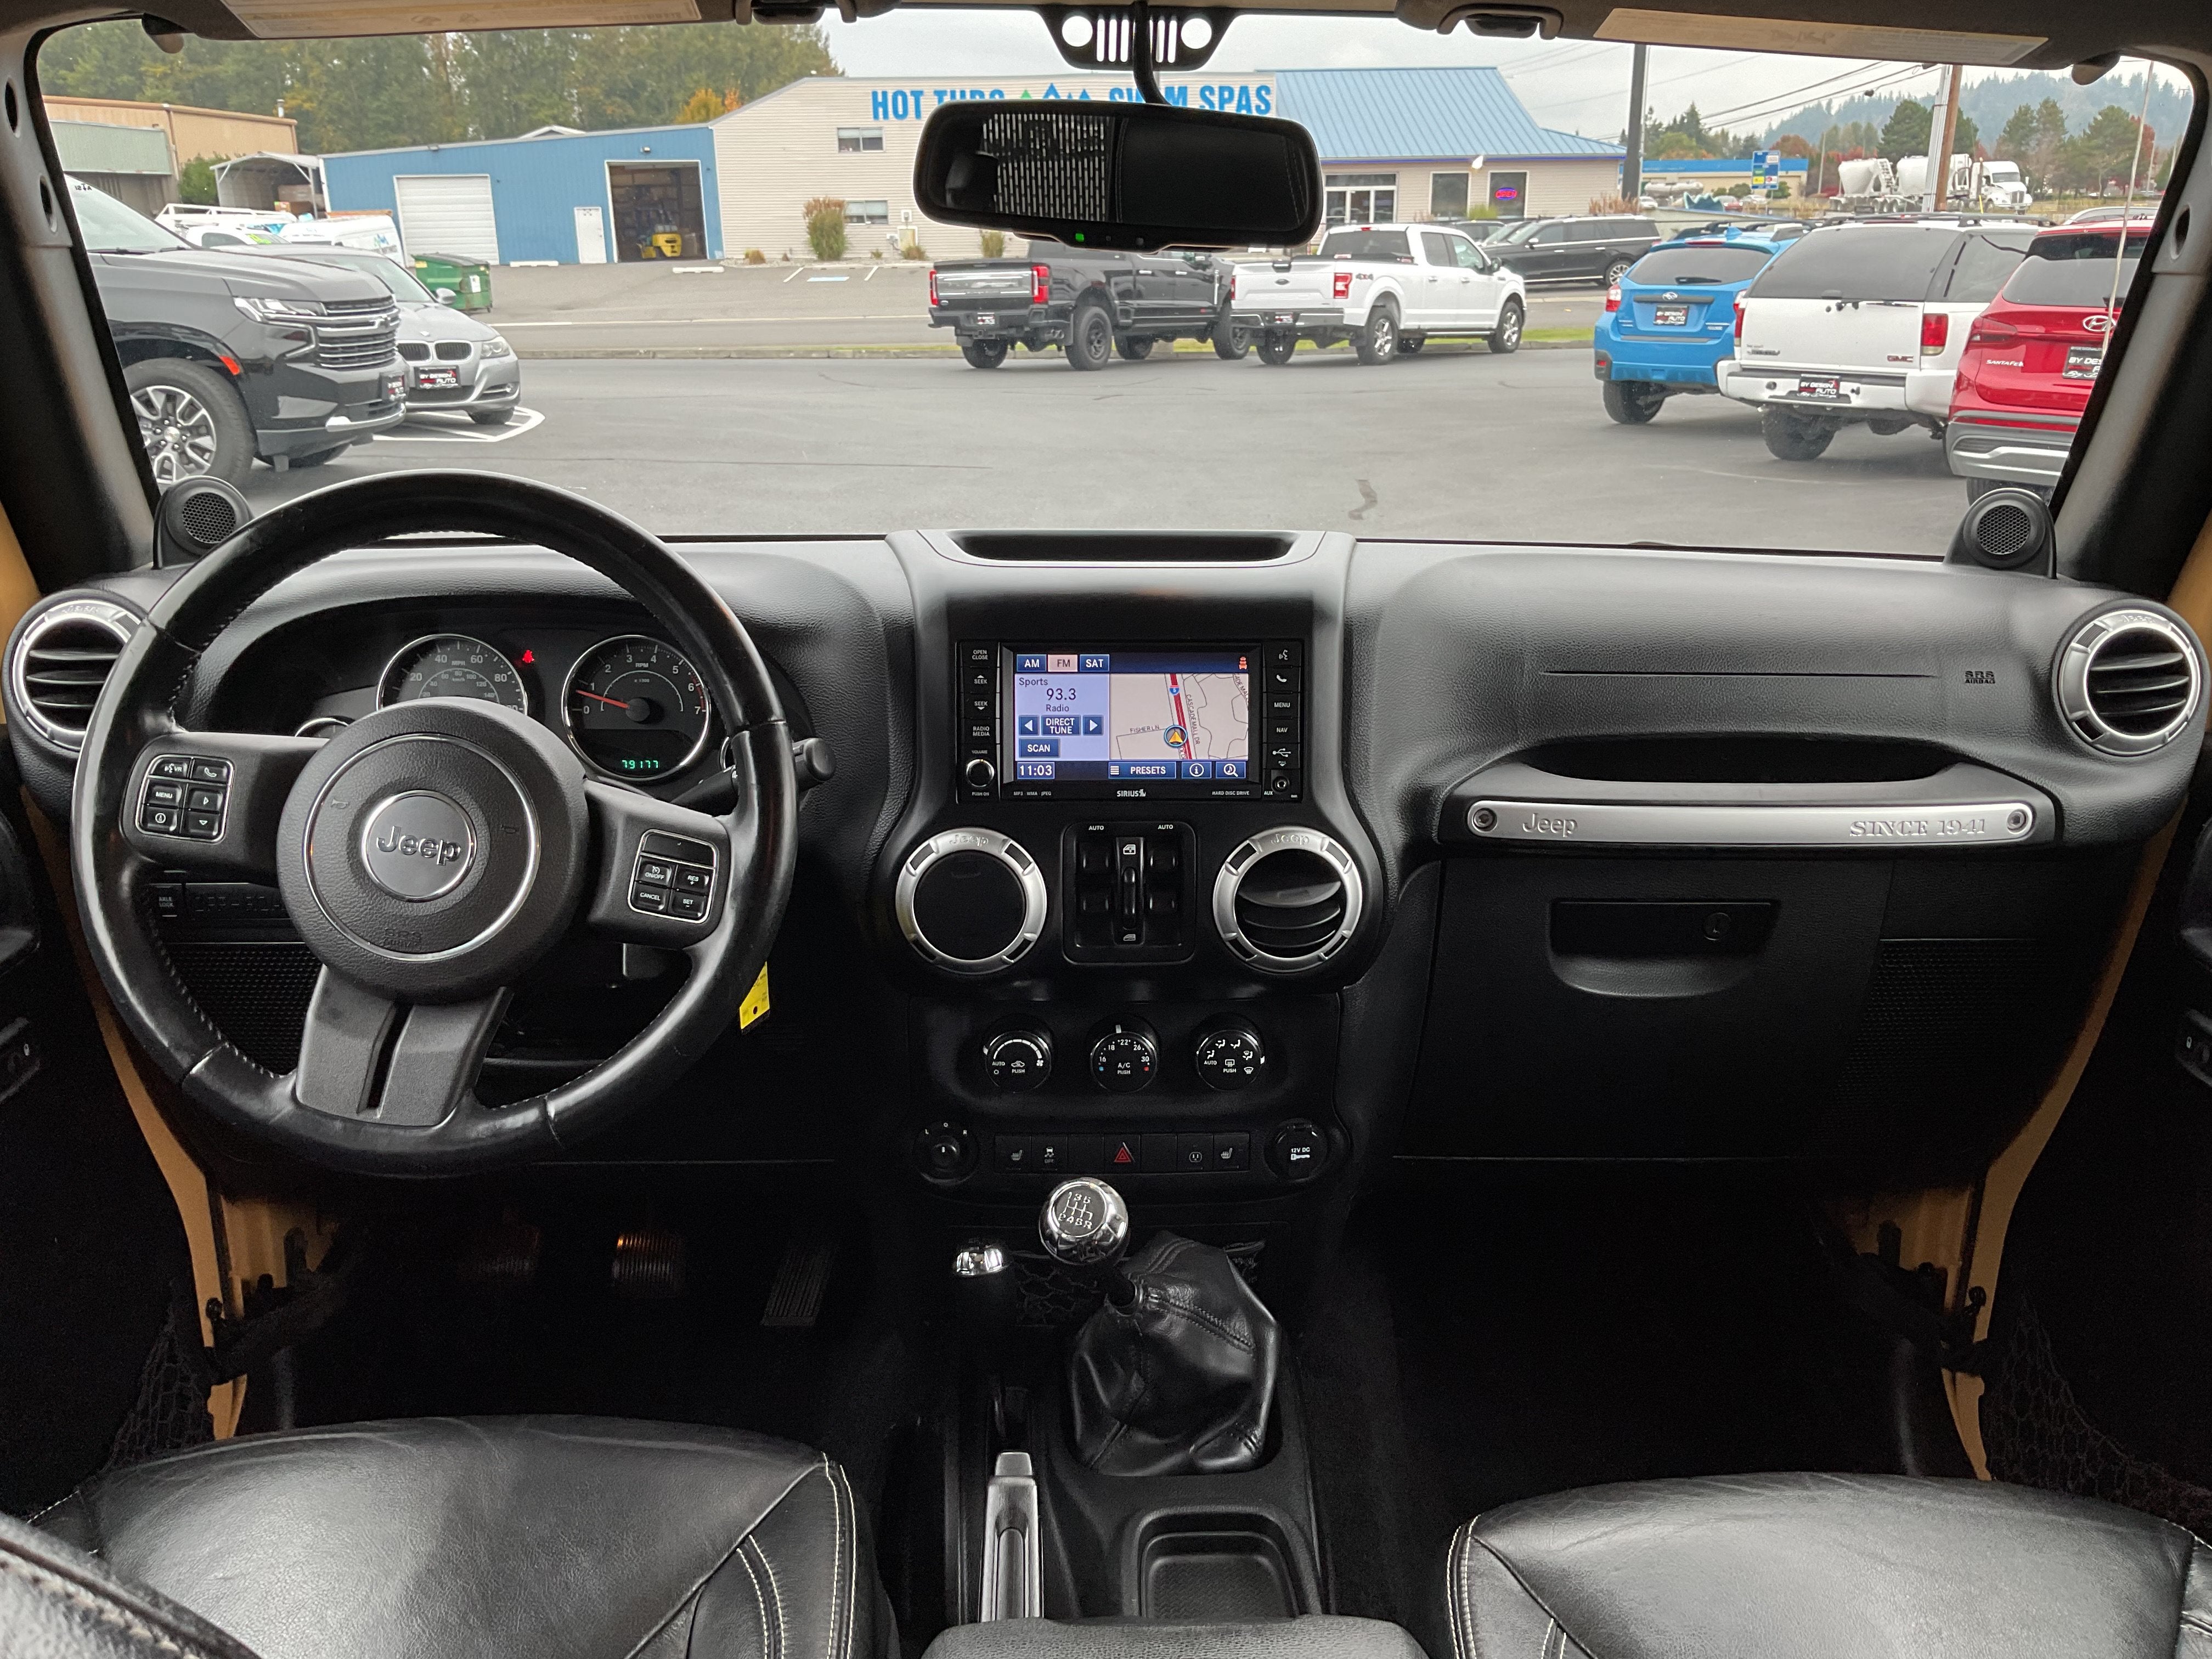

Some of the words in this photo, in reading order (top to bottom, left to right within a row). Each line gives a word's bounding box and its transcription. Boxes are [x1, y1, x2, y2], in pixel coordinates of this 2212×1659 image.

[872, 90, 924, 120] HOT
[1199, 85, 1271, 115] SPAS
[435, 654, 447, 663] 40
[471, 655, 483, 663] 60
[627, 654, 632, 663] 3
[651, 654, 657, 663] 4
[1024, 659, 1040, 668] AM
[1086, 659, 1103, 668] SAT
[605, 664, 611, 673] 2
[673, 665, 679, 674] 5
[410, 673, 422, 681] 20
[688, 683, 694, 691] 6
[1019, 678, 1048, 687] Sports
[1046, 688, 1076, 701] 93.3
[622, 760, 658, 769] 79177
[1020, 765, 1052, 776] 11:03
[1131, 766, 1166, 775] PRESETS
[1522, 812, 1578, 837] Jeep
[1849, 821, 1928, 837] SINCE
[1936, 819, 1985, 836] 1941
[949, 834, 989, 847] Jeep
[1271, 833, 1309, 845] Jeep
[376, 826, 461, 866] Jeep
[640, 892, 661, 901] CANCEL
[1084, 1220, 1092, 1229] R
